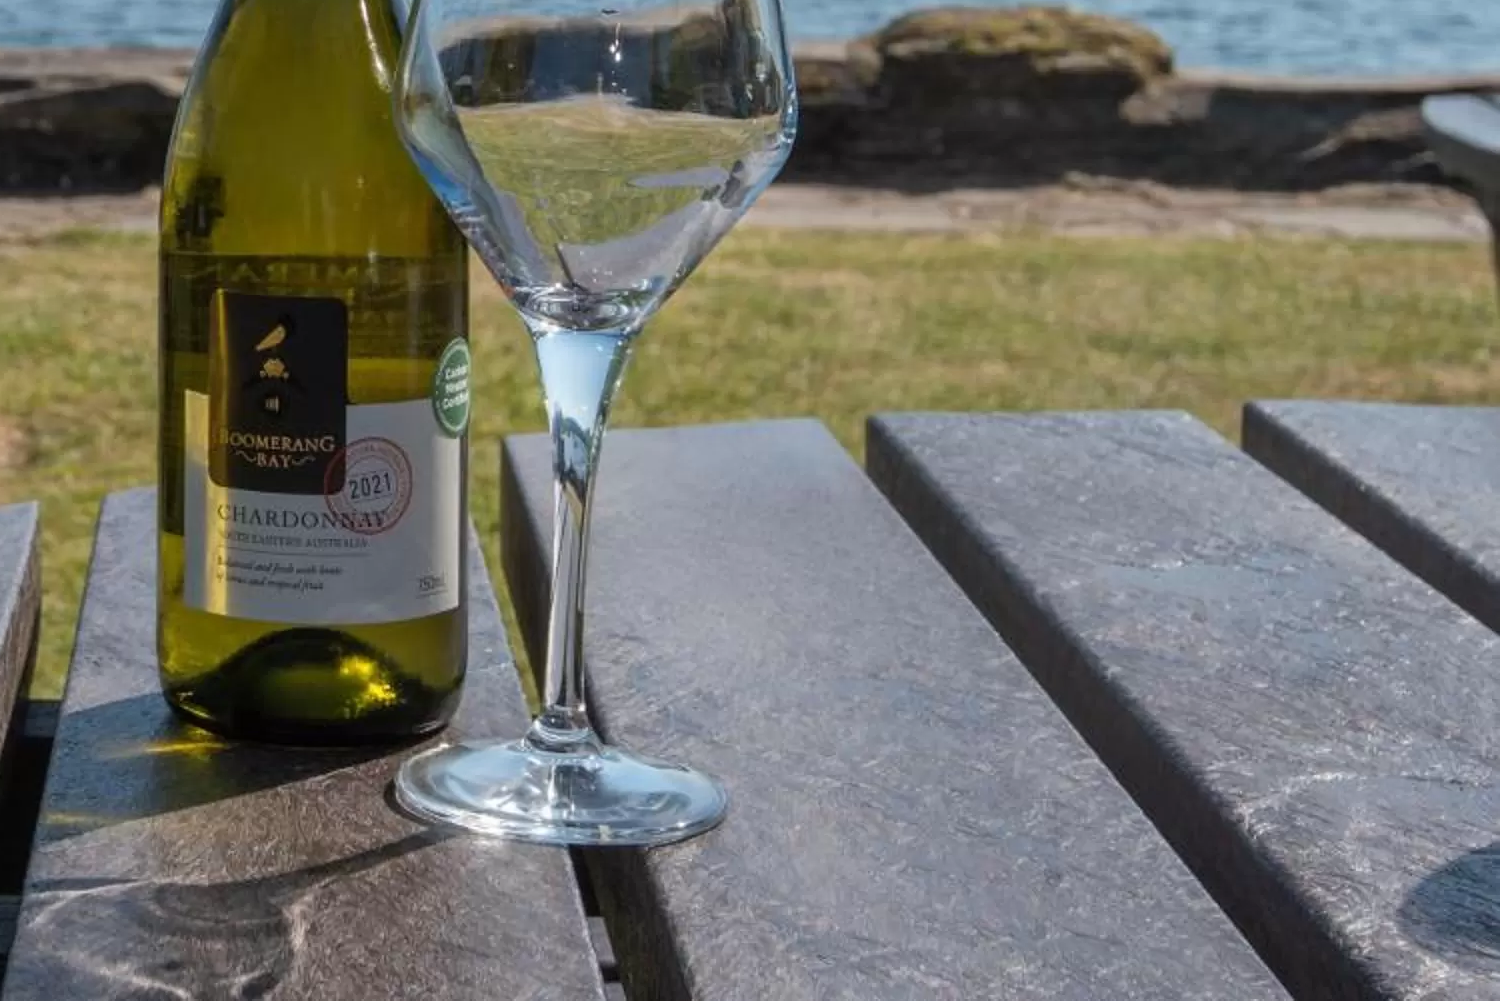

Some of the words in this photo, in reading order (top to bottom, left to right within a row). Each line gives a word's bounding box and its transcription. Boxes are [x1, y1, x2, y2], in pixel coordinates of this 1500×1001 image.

[219, 429, 336, 452] BOOMERANG
[256, 452, 293, 468] BAY
[348, 471, 392, 500] 2021
[217, 504, 388, 530] CHARDONNAY
